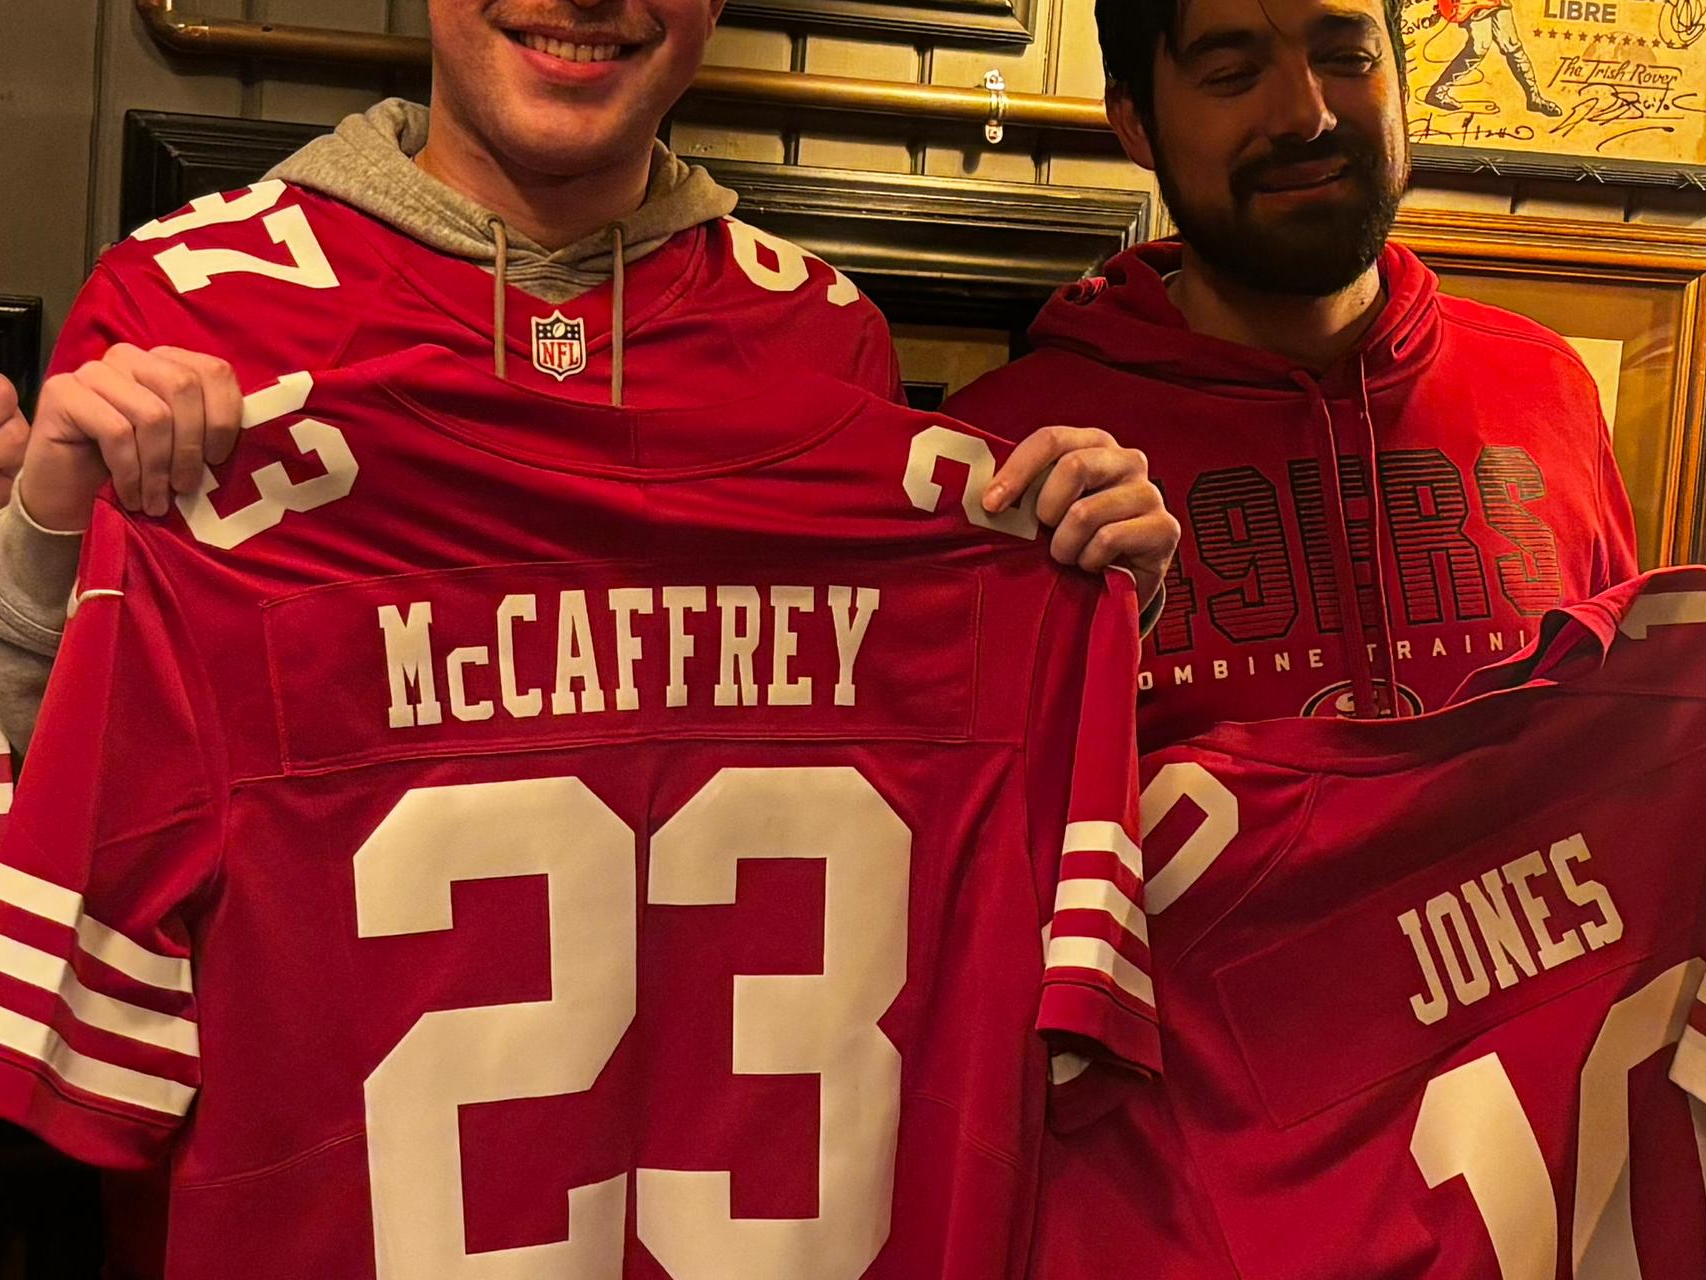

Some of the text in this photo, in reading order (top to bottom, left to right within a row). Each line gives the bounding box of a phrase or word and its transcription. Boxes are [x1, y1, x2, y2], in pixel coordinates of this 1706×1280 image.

[1547, 57, 1583, 88] The
[541, 341, 580, 370] NFL
[378, 585, 880, 729] McCAFFREY
[1138, 628, 1526, 692] OMBINE TRAINI
[1397, 833, 1624, 1025] JONES
